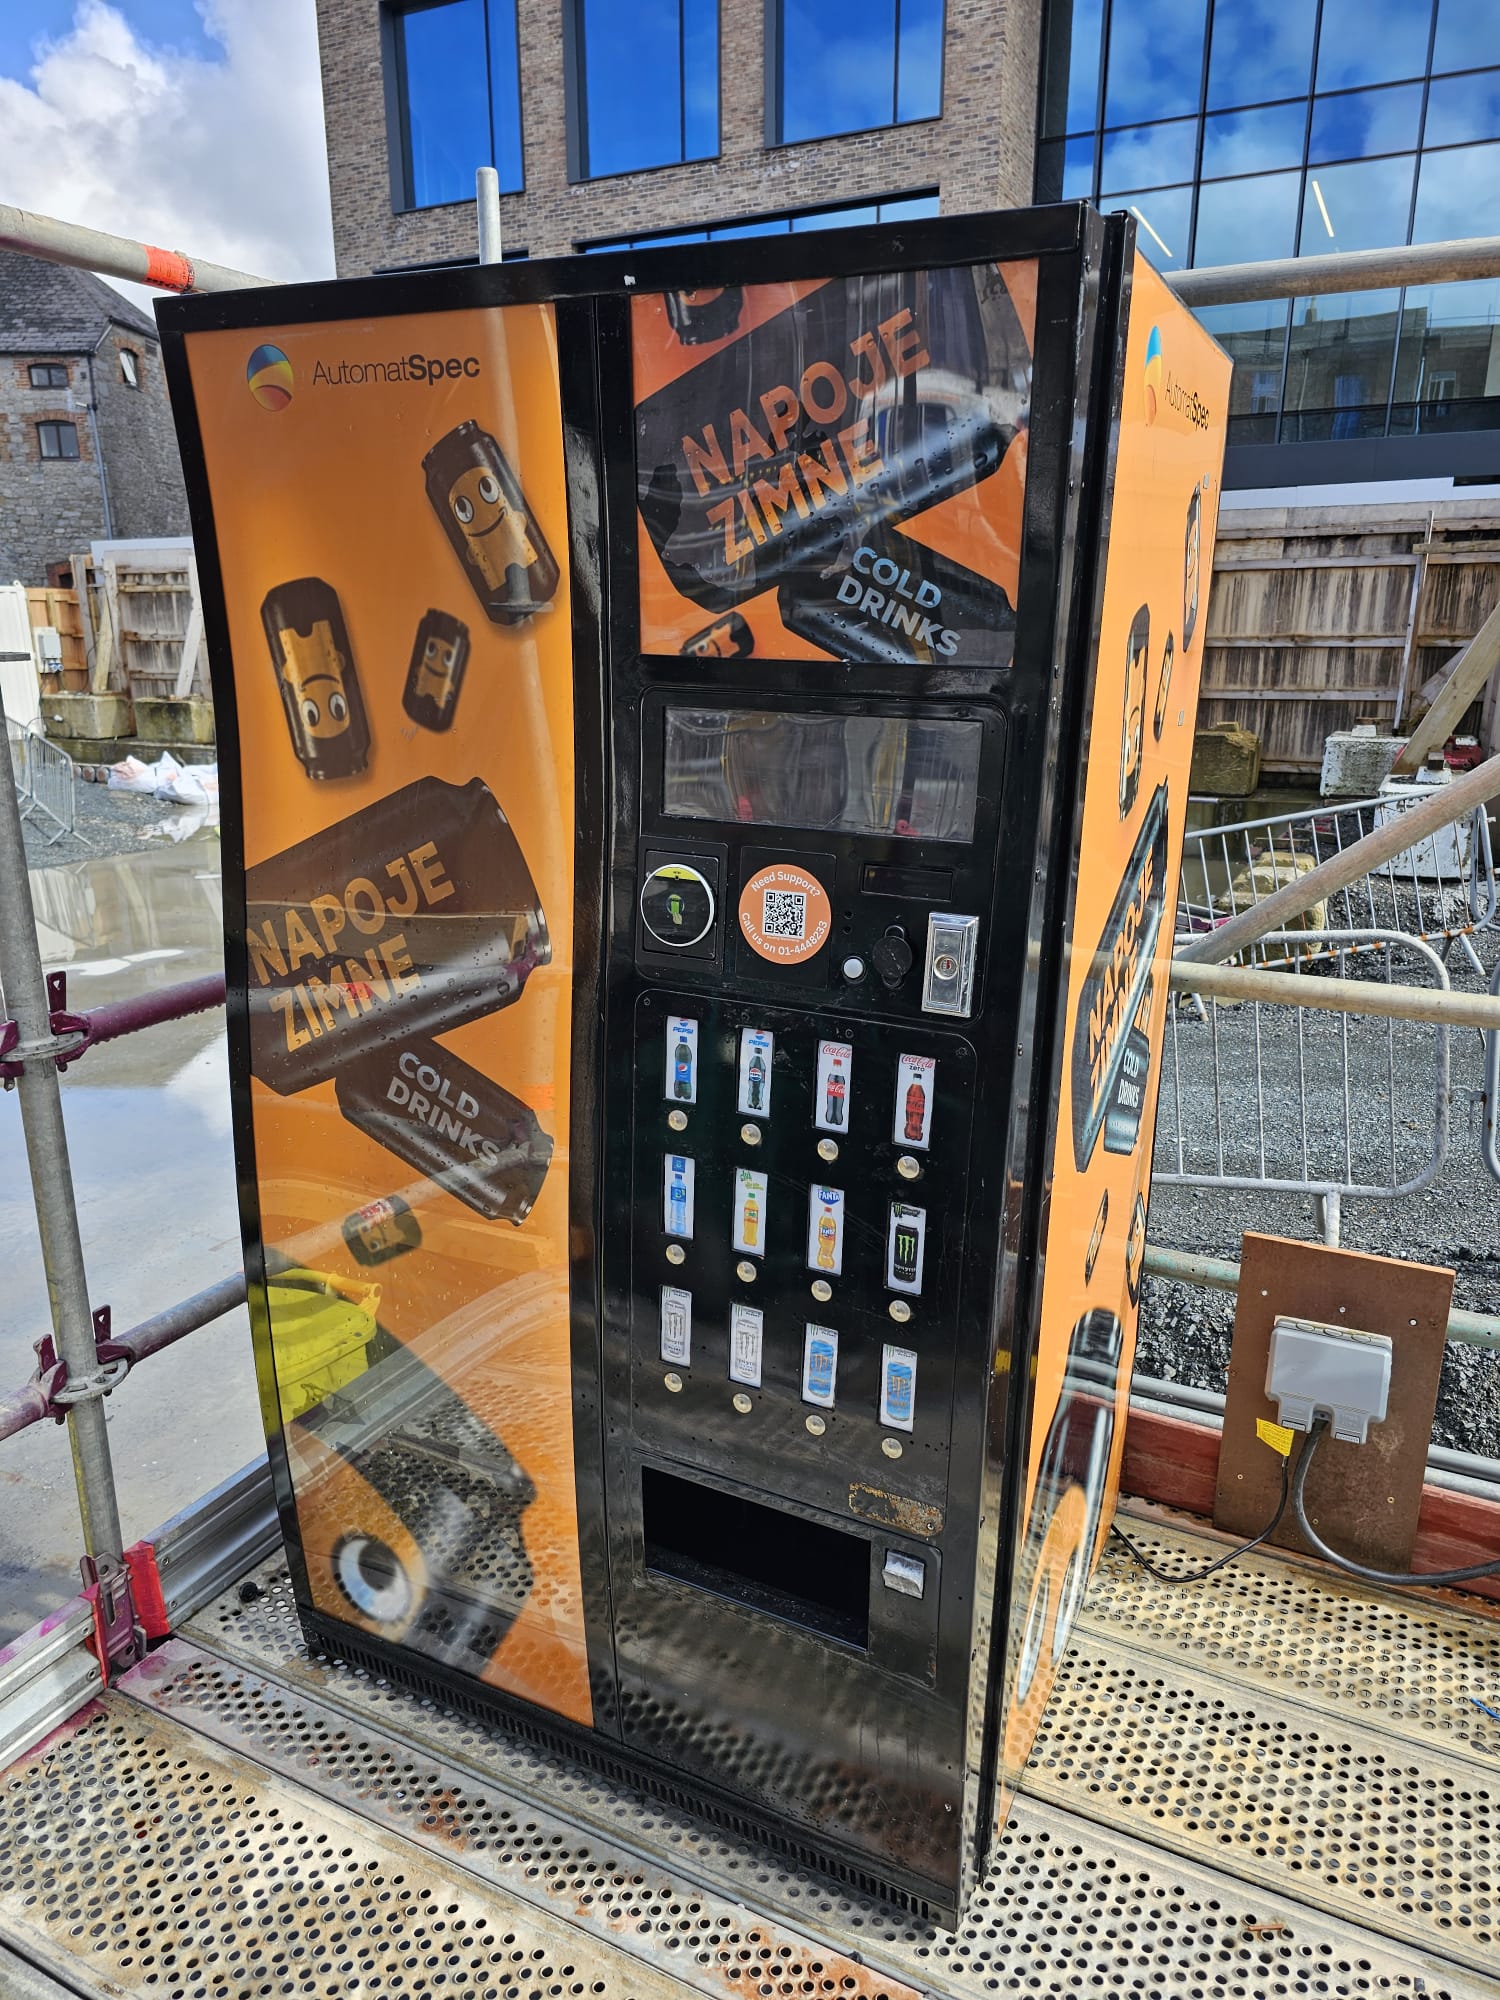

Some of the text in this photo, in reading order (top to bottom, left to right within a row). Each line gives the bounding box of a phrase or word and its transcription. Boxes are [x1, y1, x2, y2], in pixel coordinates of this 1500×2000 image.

[312, 353, 481, 387] AutomatSpec
[1165, 370, 1209, 431] AutomatSpec
[681, 308, 930, 497] NAPOJE
[707, 419, 885, 567] ZIMNE
[852, 547, 942, 609] COLD
[836, 575, 961, 658] DRINKS
[246, 841, 456, 986] NAPOJE
[751, 871, 821, 897] Need Support?
[742, 912, 756, 933] Call
[752, 932, 763, 945] us
[763, 942, 776, 953] on
[778, 920, 828, 956] 01-4448233
[269, 934, 421, 1053] ZIMNE
[672, 1026, 694, 1034] PEPSI
[748, 1039, 770, 1048] PEPSI
[398, 1051, 480, 1120] COLD
[1123, 1048, 1139, 1078] COLD
[386, 1076, 501, 1167] DRINKS
[818, 1189, 840, 1201] FANTA
